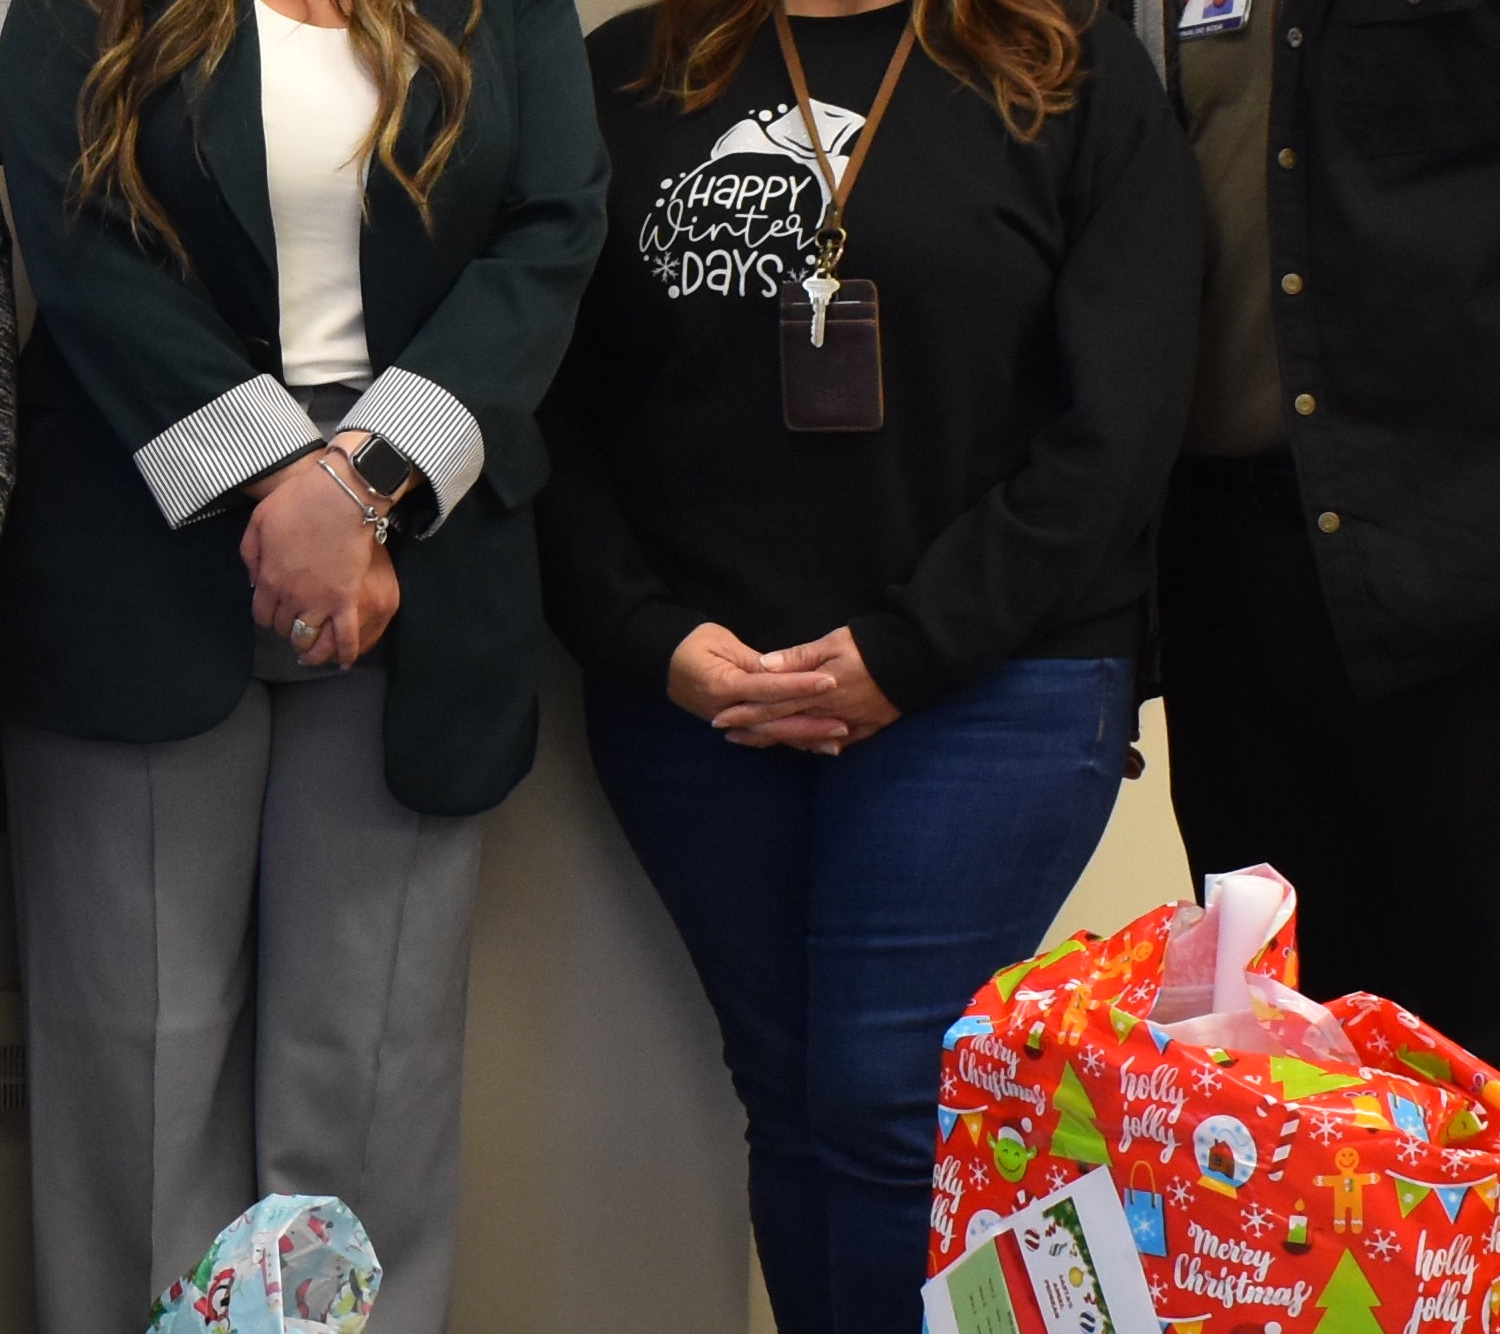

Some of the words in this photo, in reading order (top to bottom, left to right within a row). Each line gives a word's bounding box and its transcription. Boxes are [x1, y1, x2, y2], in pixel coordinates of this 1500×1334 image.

[639, 198, 815, 252] Winter
[958, 1048, 1046, 1115] Christmas
[969, 1034, 1020, 1079] Merry
[1119, 1055, 1188, 1124] holly
[1118, 1104, 1182, 1164] jolly
[930, 1197, 957, 1254] lly
[1188, 1219, 1276, 1282] Merry
[1173, 1254, 1312, 1318] Christmas
[1415, 1229, 1480, 1294] holly
